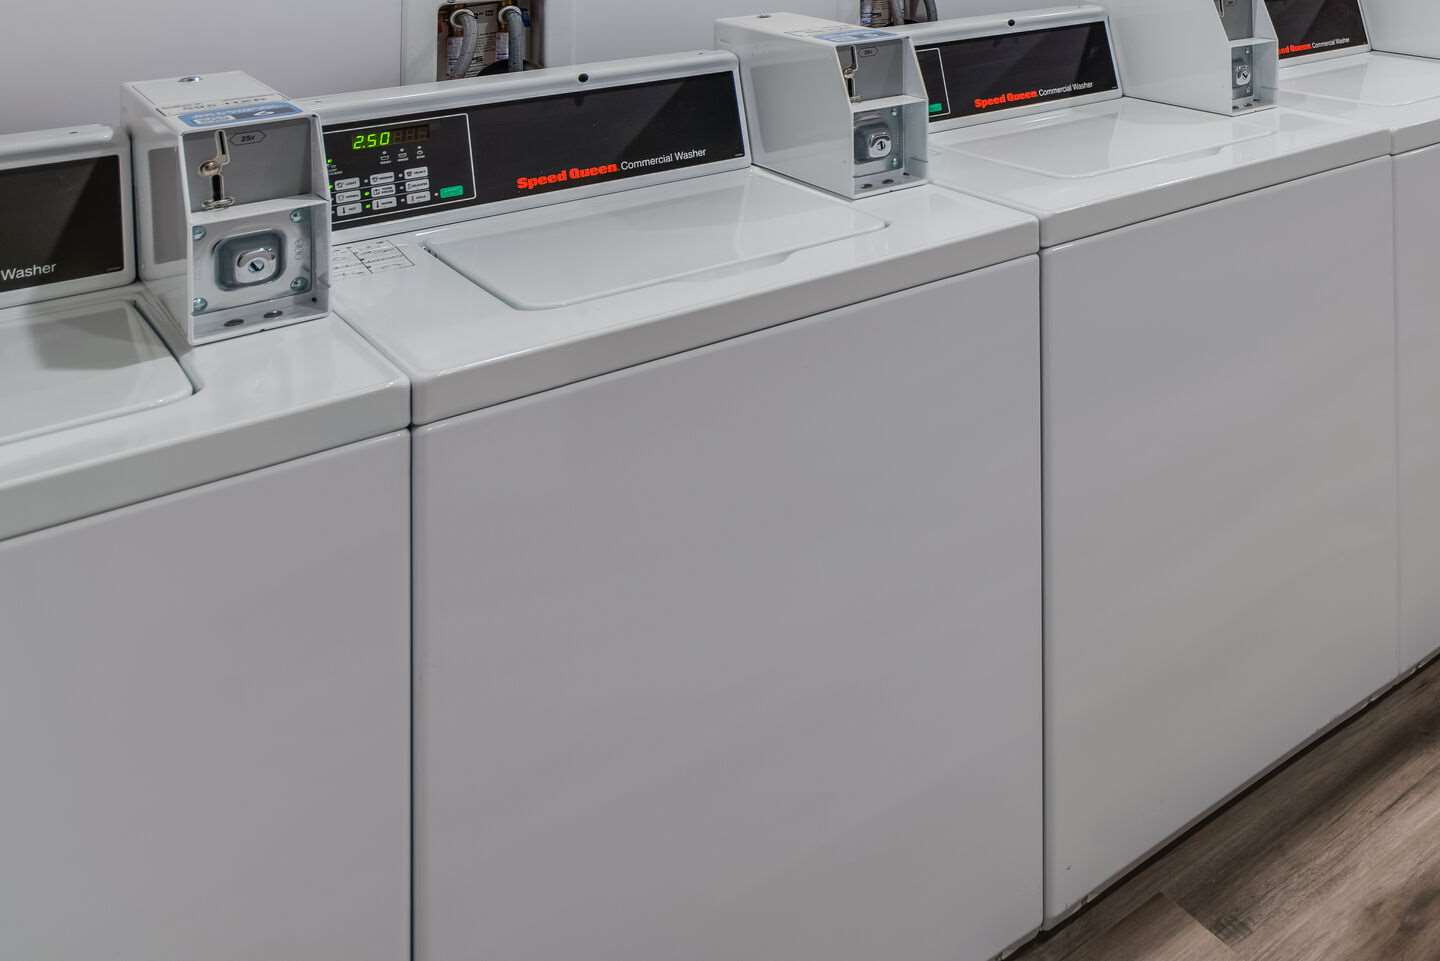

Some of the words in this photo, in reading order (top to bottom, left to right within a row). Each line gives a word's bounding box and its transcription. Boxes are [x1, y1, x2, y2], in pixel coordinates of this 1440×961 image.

[974, 93, 1006, 109] Speed
[1006, 90, 1038, 103] Queen
[1039, 84, 1072, 97] Commercial
[1072, 81, 1093, 91] Washer
[352, 130, 391, 150] 2.50
[516, 169, 568, 190] Speed
[569, 162, 619, 180] Queen
[620, 153, 673, 171] Commercial
[674, 148, 707, 162] Washer
[0, 263, 57, 281] Washer
